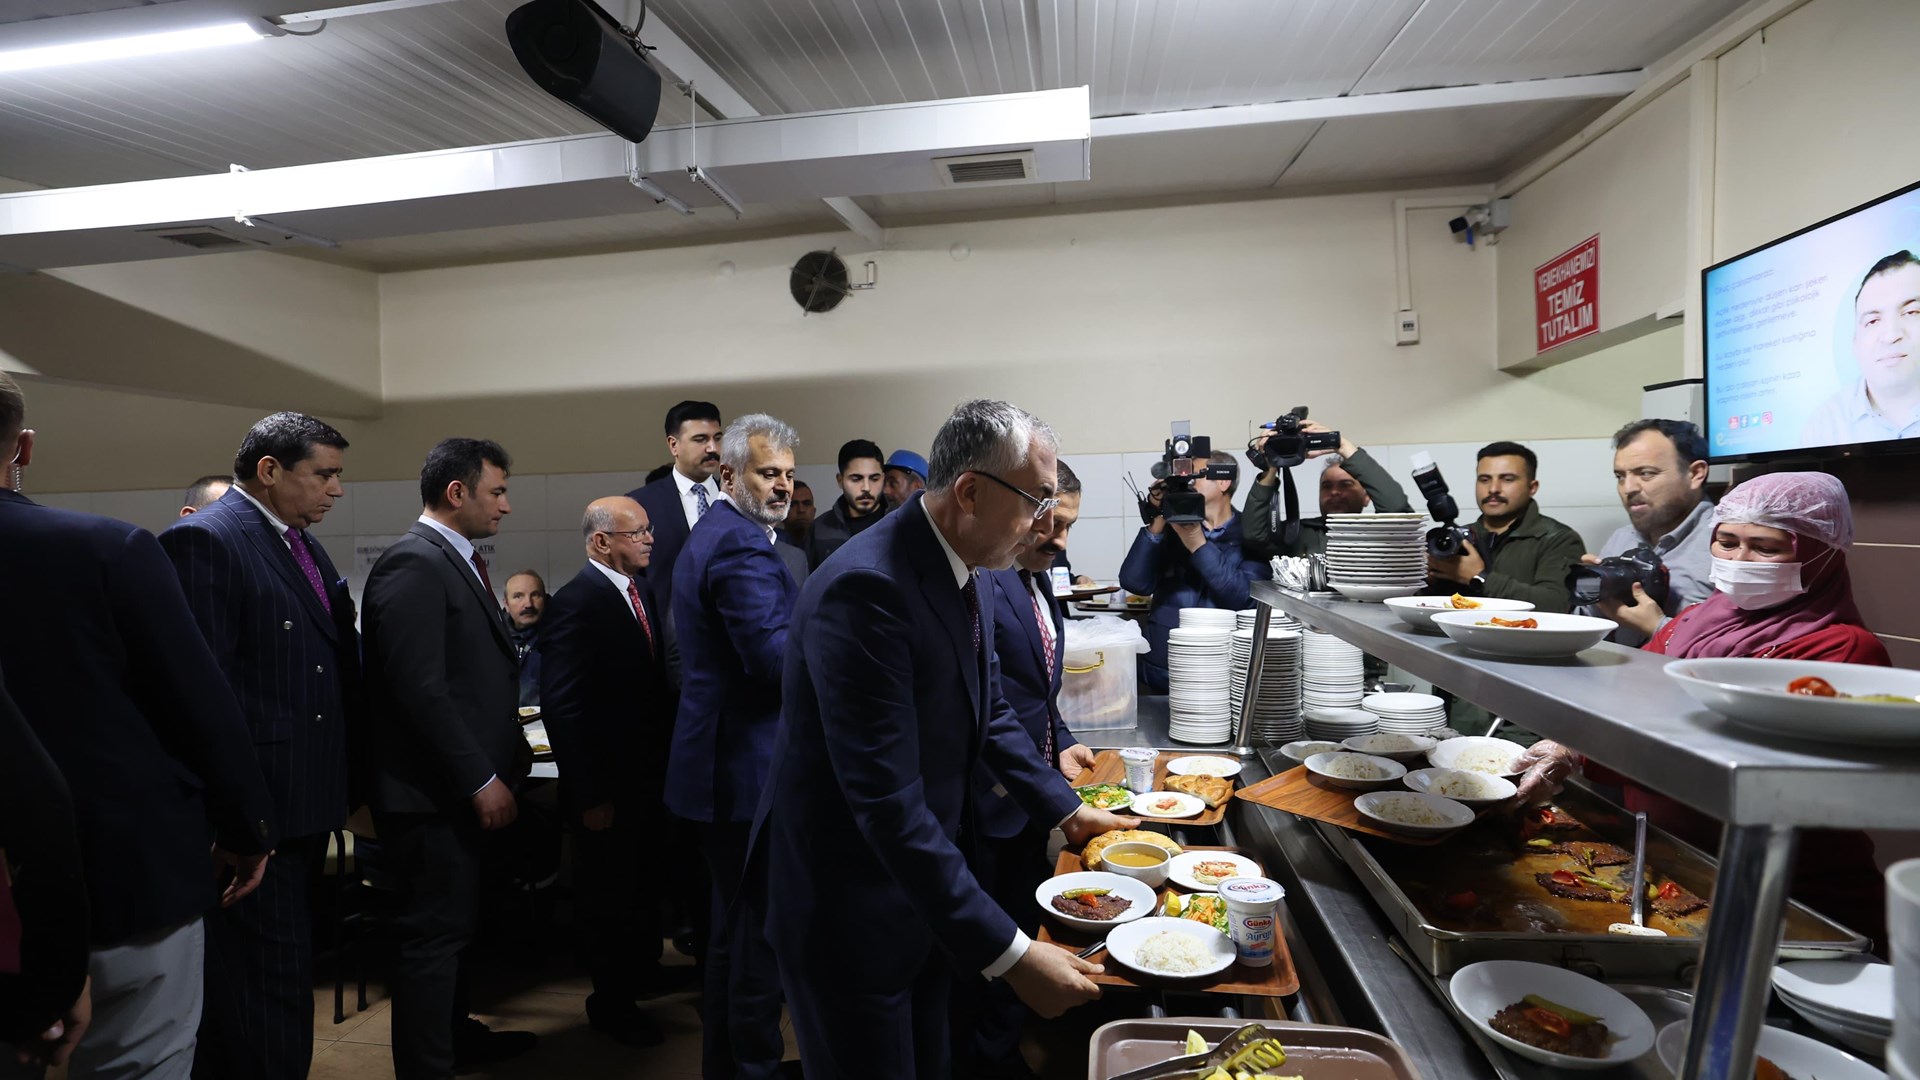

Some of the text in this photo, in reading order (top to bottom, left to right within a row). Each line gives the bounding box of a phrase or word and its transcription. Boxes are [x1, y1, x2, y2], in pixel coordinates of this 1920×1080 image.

[1538, 241, 1596, 292] YEMEKHANEMİZİ
[1547, 278, 1585, 317] TEMİZ
[1541, 302, 1593, 343] TUTALIM
